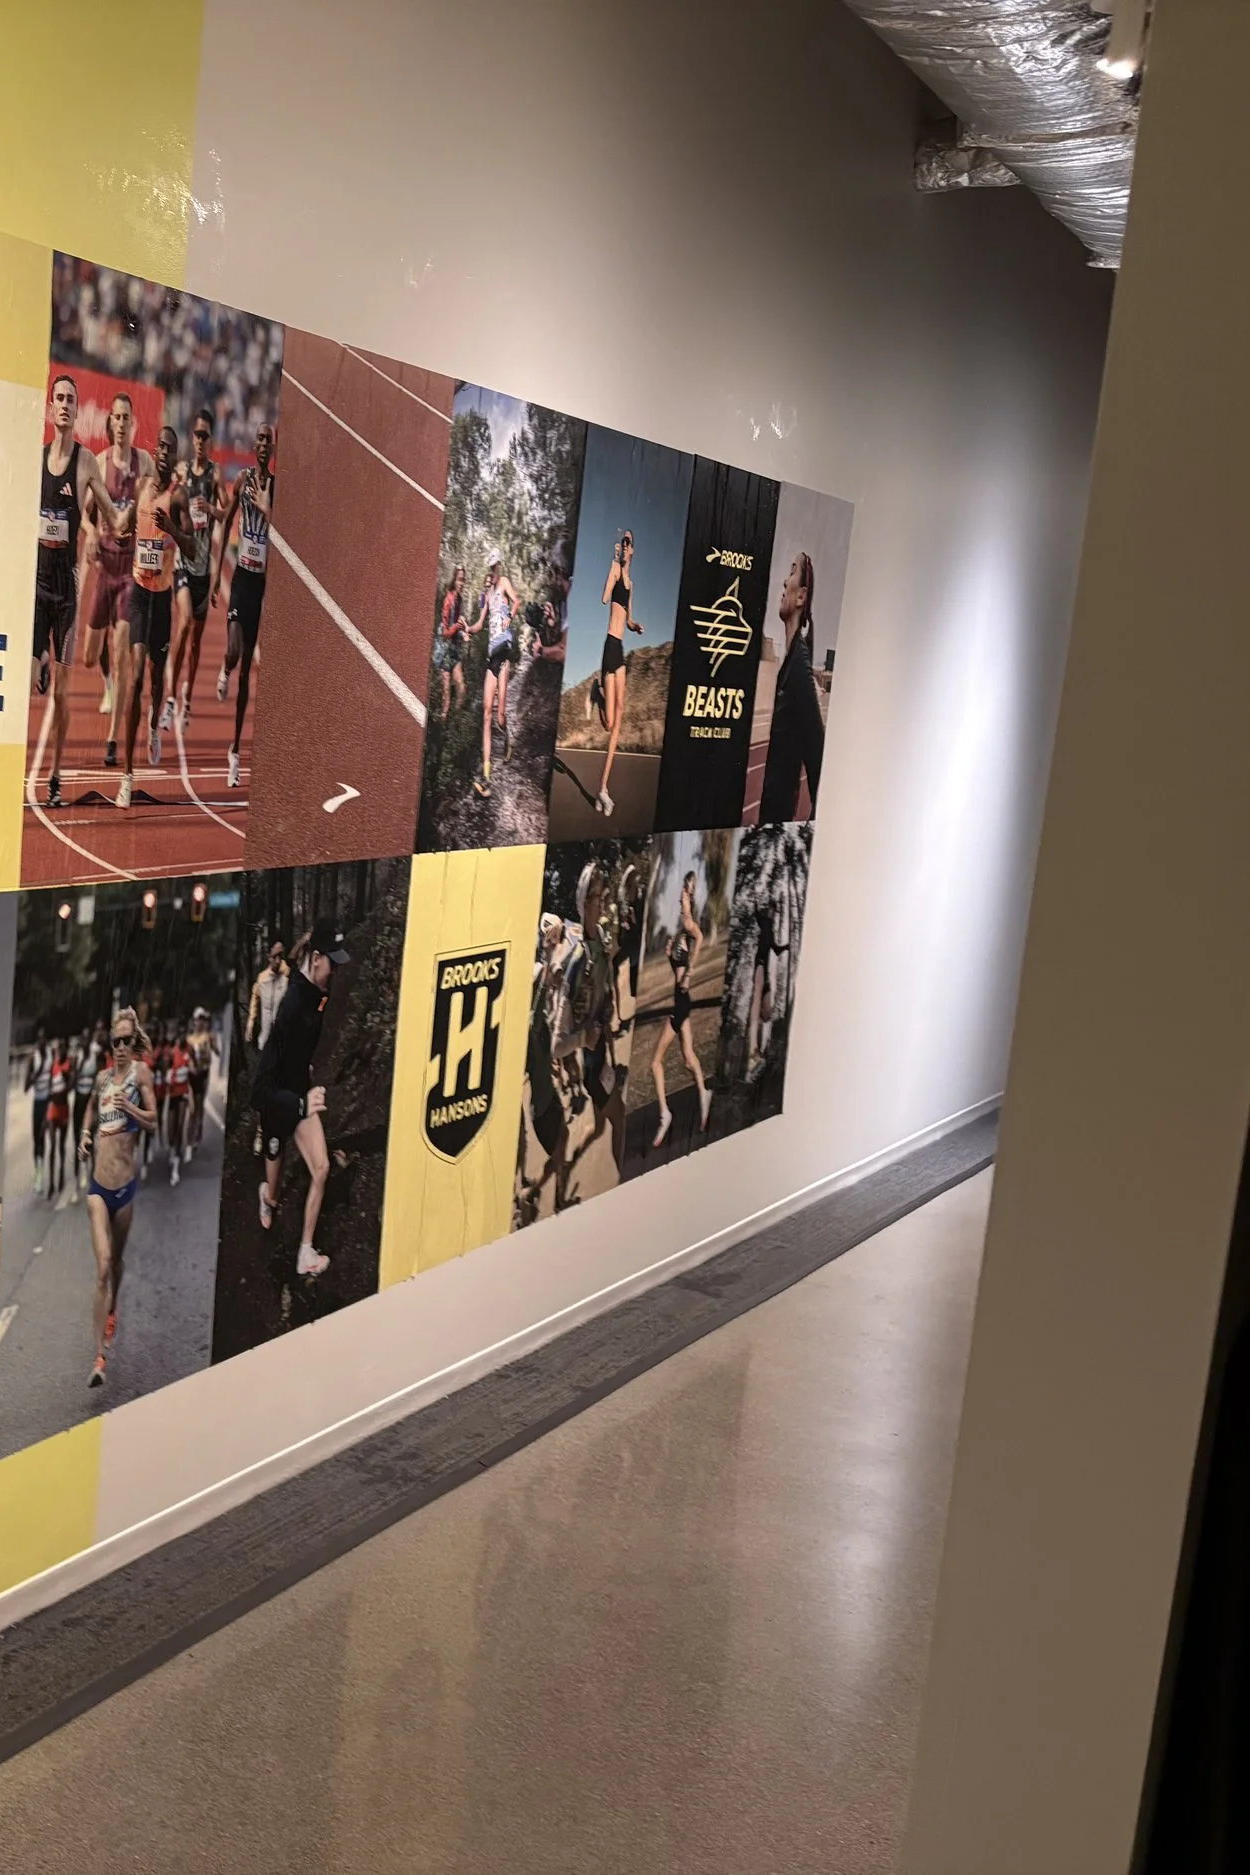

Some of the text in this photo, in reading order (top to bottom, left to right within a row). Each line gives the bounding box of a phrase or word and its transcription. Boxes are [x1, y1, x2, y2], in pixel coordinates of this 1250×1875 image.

[720, 550, 754, 571] BROOKS
[682, 684, 745, 720] BEASTS
[690, 725, 731, 739] TRACK CLUB
[441, 958, 502, 990] BROOKS
[430, 1094, 489, 1129] HANSONS
